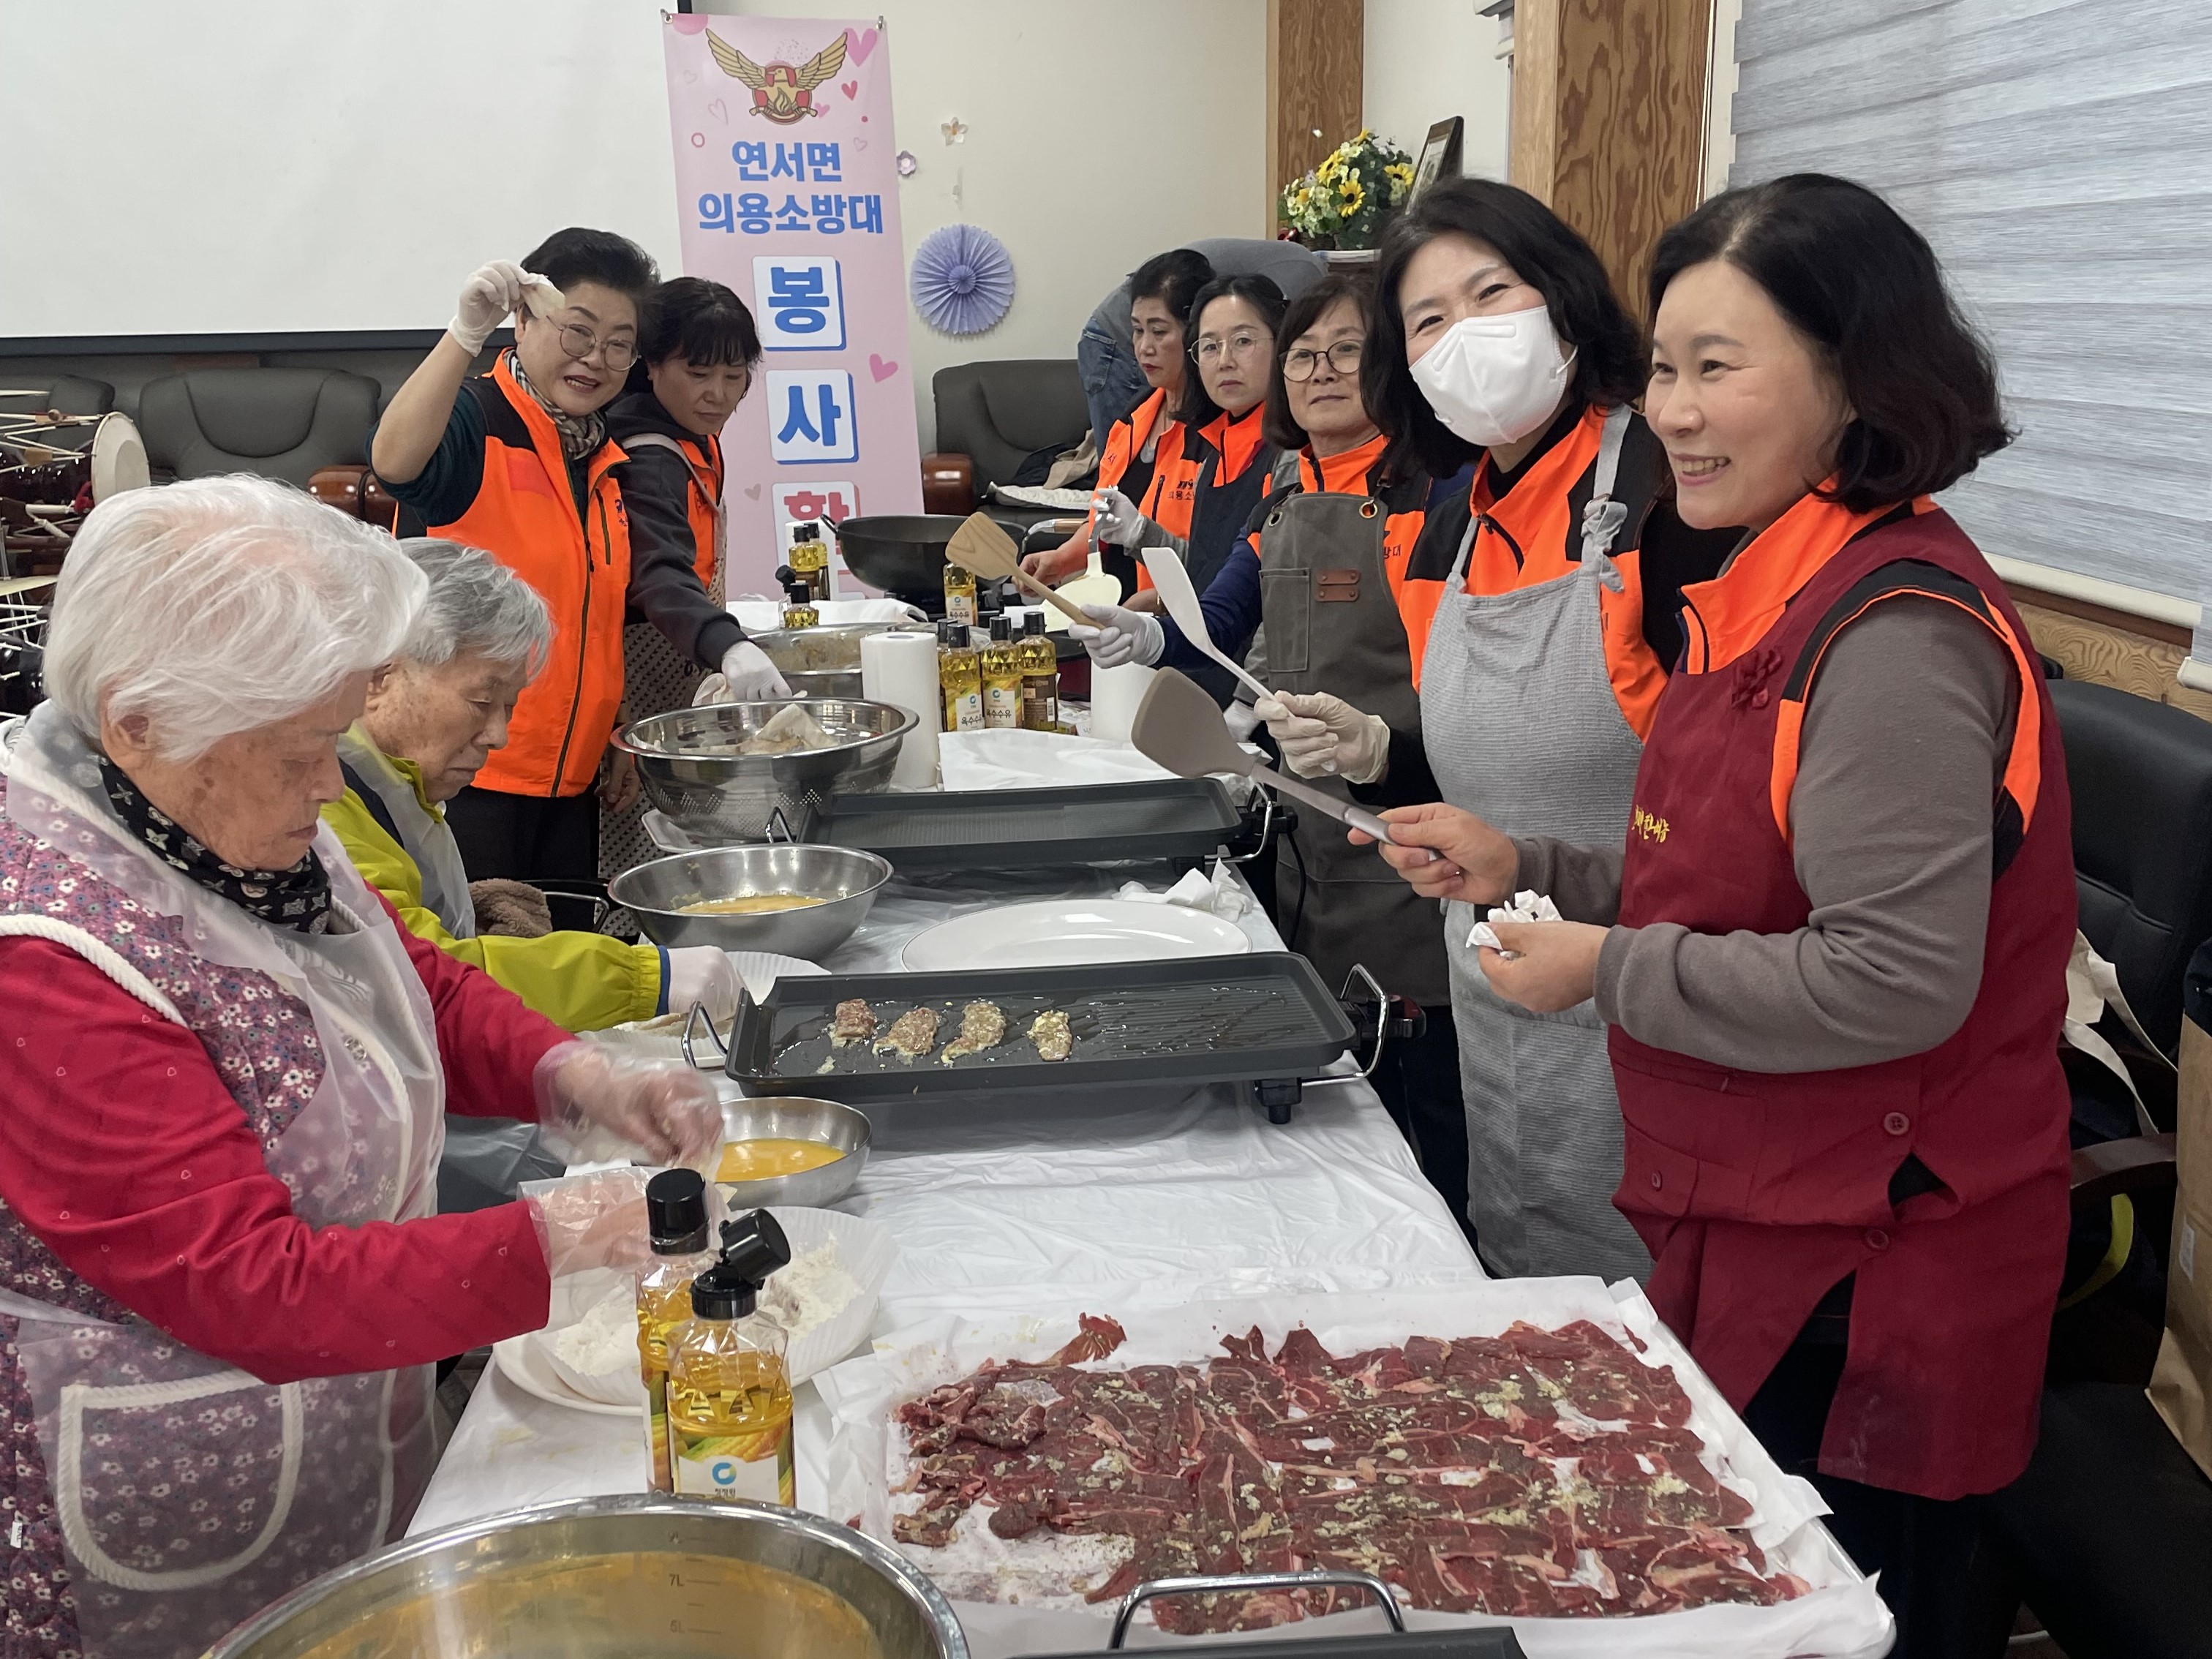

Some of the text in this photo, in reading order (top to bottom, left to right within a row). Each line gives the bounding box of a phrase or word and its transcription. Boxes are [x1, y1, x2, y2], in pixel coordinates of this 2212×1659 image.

[731, 141, 842, 182] 연서면
[699, 193, 883, 235] 의용소방대
[1168, 490, 1195, 500] 의용소
[669, 1573, 685, 1587] 7L
